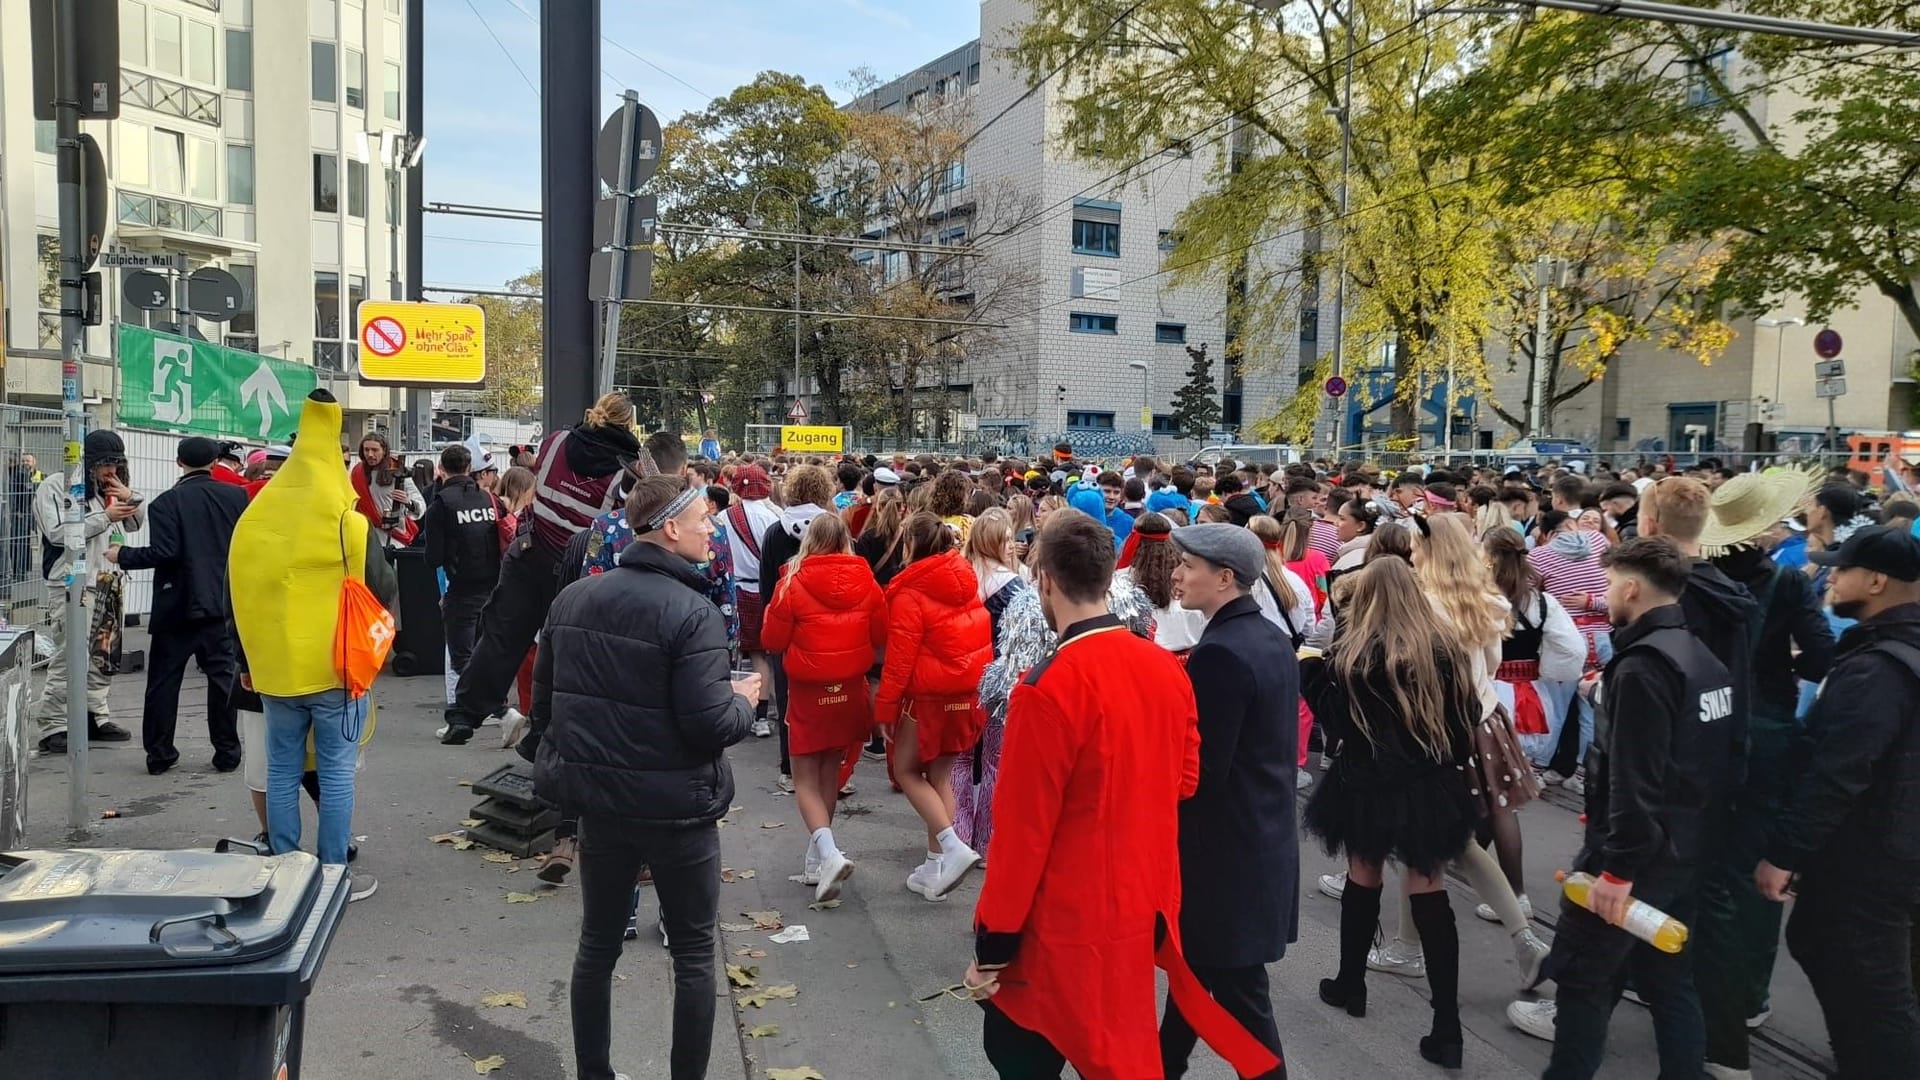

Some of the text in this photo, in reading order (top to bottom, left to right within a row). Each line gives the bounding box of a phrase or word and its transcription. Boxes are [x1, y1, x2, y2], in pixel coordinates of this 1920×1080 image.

[105, 254, 173, 266] Zülpicher Wall
[416, 328, 443, 341] Mehr
[416, 342, 469, 353] ohne Glas
[787, 431, 837, 446] Zugang
[560, 480, 592, 498] SUPERVISOR
[456, 507, 496, 524] NCIS
[818, 694, 848, 705] LIFEGUARD
[1699, 686, 1733, 722] SWAT
[944, 702, 970, 711] LIFEGUARD
